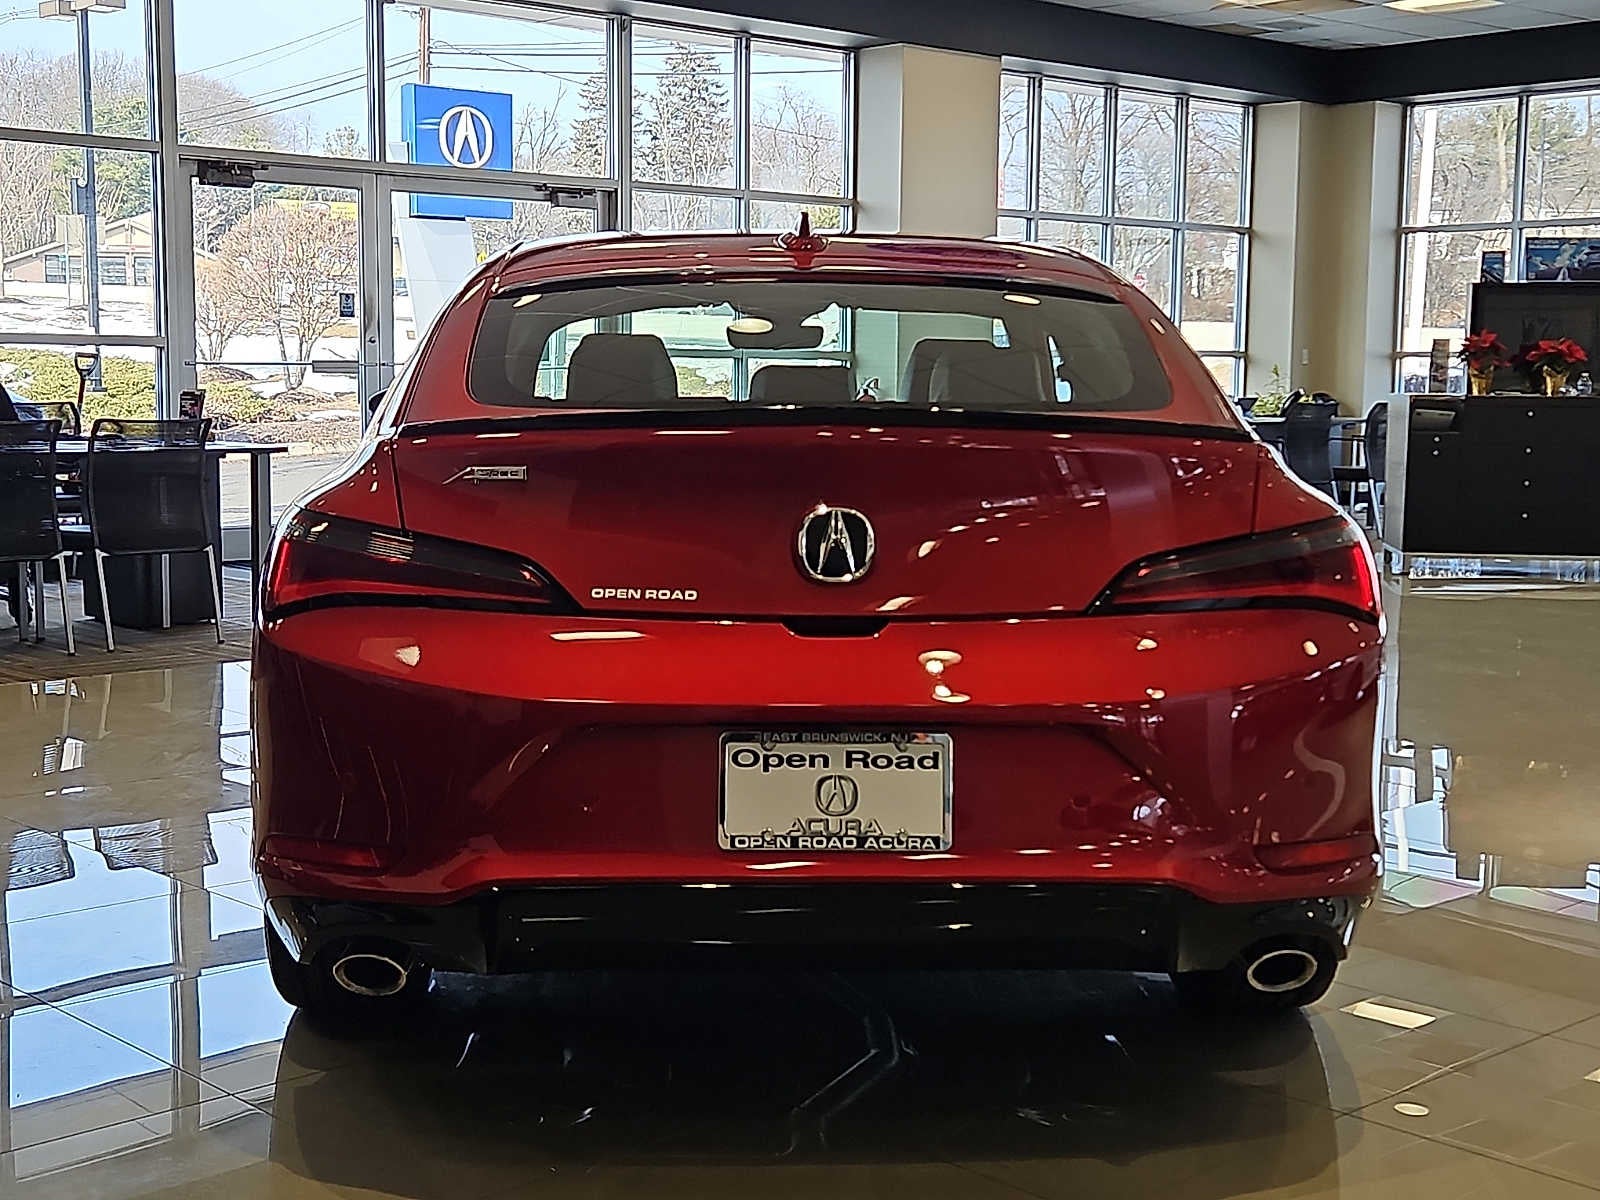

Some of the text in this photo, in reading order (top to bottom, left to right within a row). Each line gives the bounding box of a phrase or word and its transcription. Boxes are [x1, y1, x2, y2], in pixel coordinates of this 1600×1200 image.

[591, 588, 698, 601] OPEN ROAD
[763, 732, 799, 742] EAST
[890, 732, 909, 743] NJ
[731, 749, 940, 773] Open Road
[786, 817, 884, 836] ACURA
[734, 836, 936, 849] OPEN ROAD ACURA
